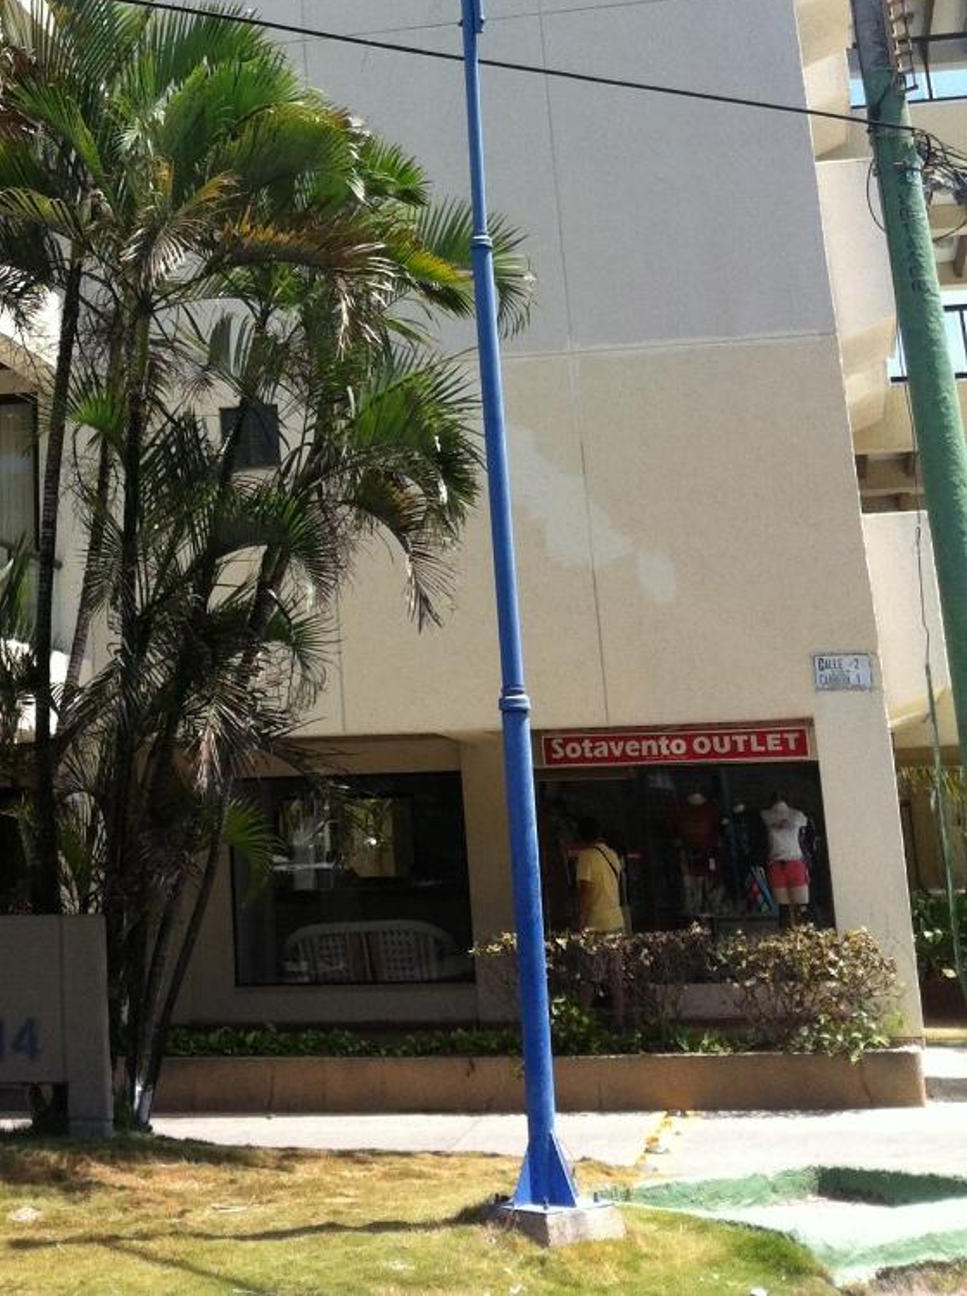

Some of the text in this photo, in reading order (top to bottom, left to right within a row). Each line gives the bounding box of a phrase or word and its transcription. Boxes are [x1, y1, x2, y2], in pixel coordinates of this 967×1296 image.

[818, 657, 843, 671] CALLE
[551, 732, 799, 759] Sotavento OUTLET
